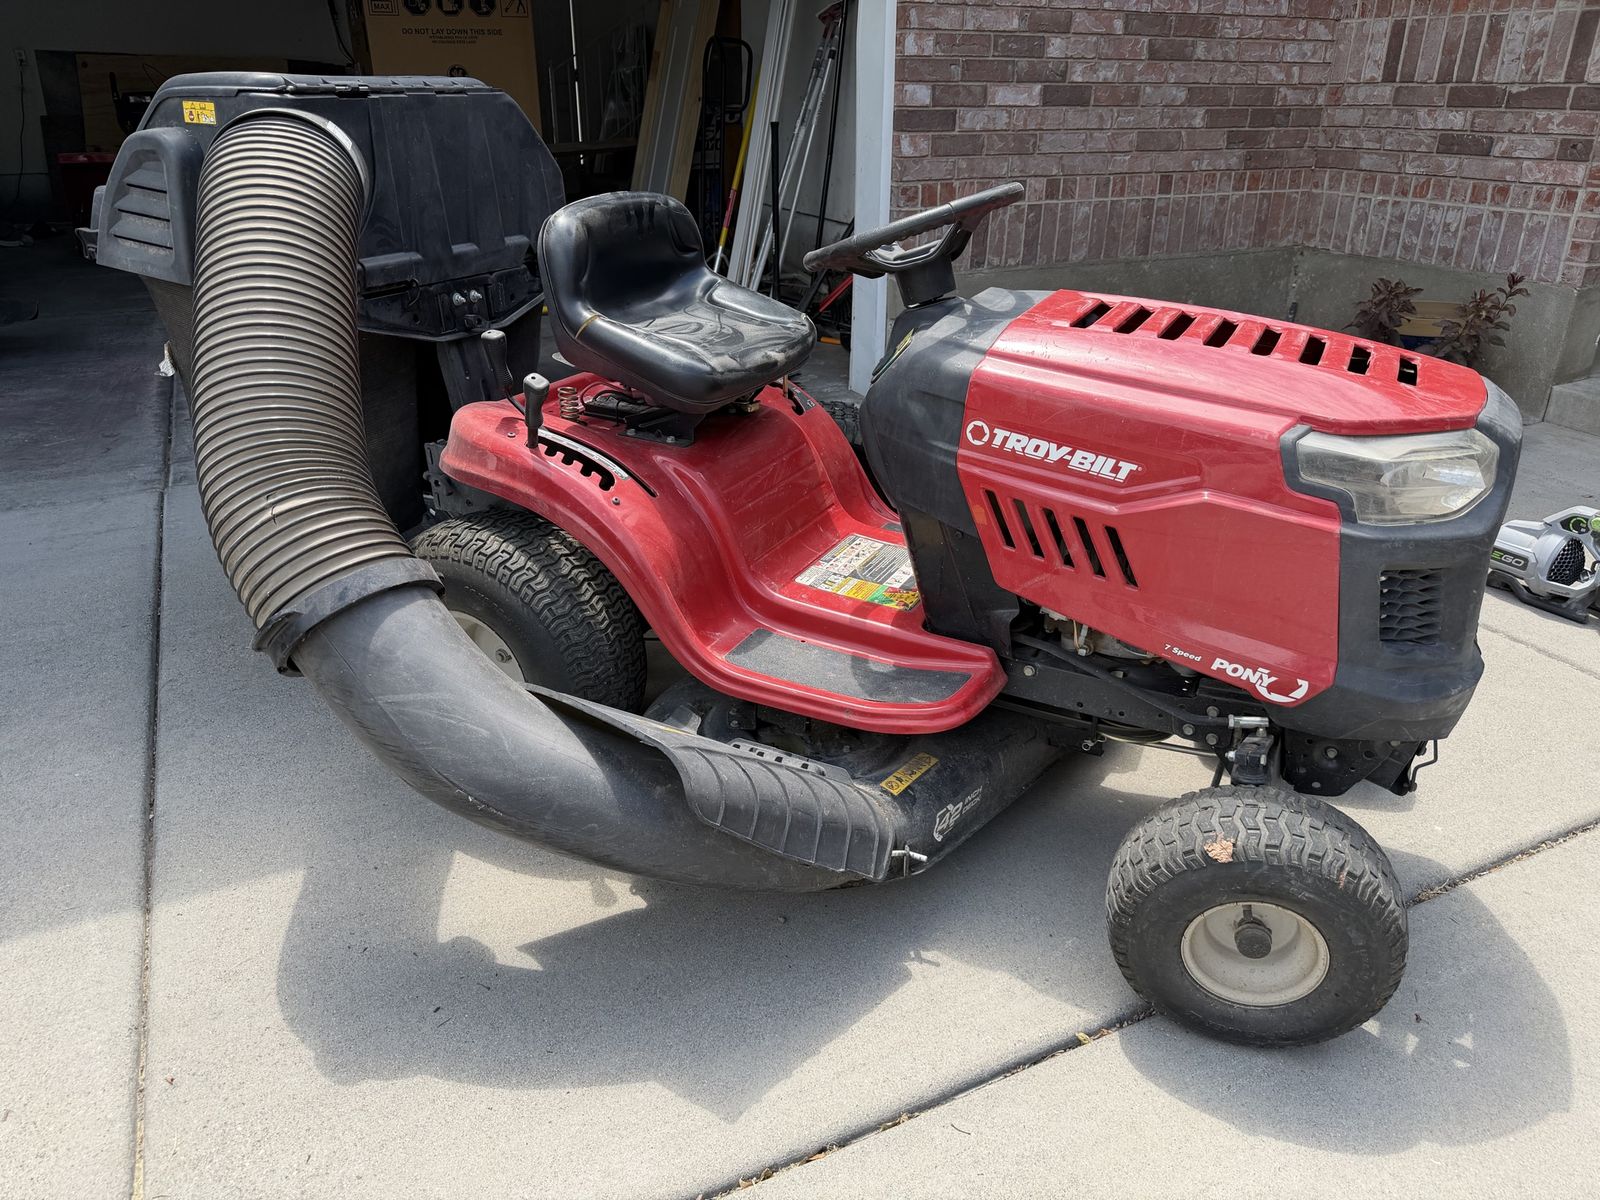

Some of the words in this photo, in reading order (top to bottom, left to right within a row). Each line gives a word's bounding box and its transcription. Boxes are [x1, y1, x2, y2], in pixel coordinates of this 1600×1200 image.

[991, 428, 1138, 483] TROY-BILT
[1491, 550, 1525, 567] EGO
[1172, 647, 1202, 662] Speed
[1210, 657, 1279, 687] PONY
[936, 802, 963, 832] 42
[964, 785, 983, 804] INCH
[962, 797, 981, 814] DECK
